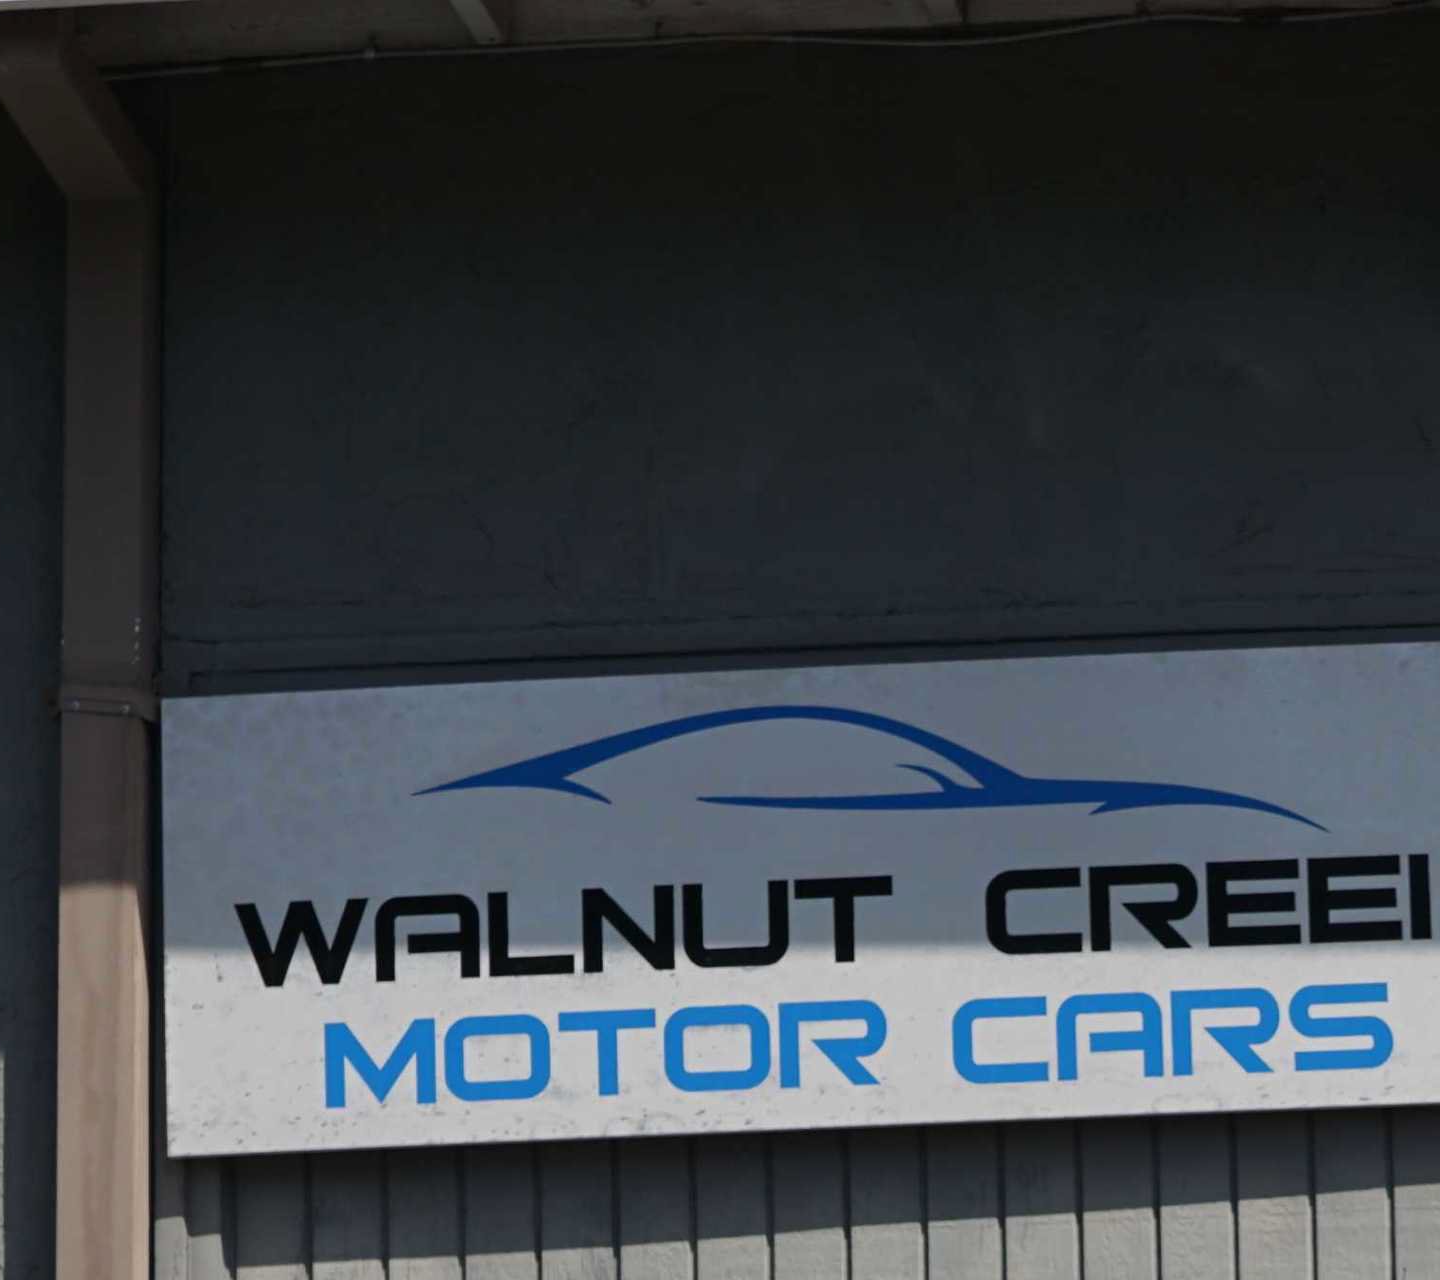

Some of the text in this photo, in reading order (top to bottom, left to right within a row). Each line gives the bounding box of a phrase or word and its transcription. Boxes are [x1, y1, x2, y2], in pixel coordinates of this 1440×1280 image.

[235, 873, 893, 988] WALNUT
[323, 981, 1396, 1110] MOTOR CARS
